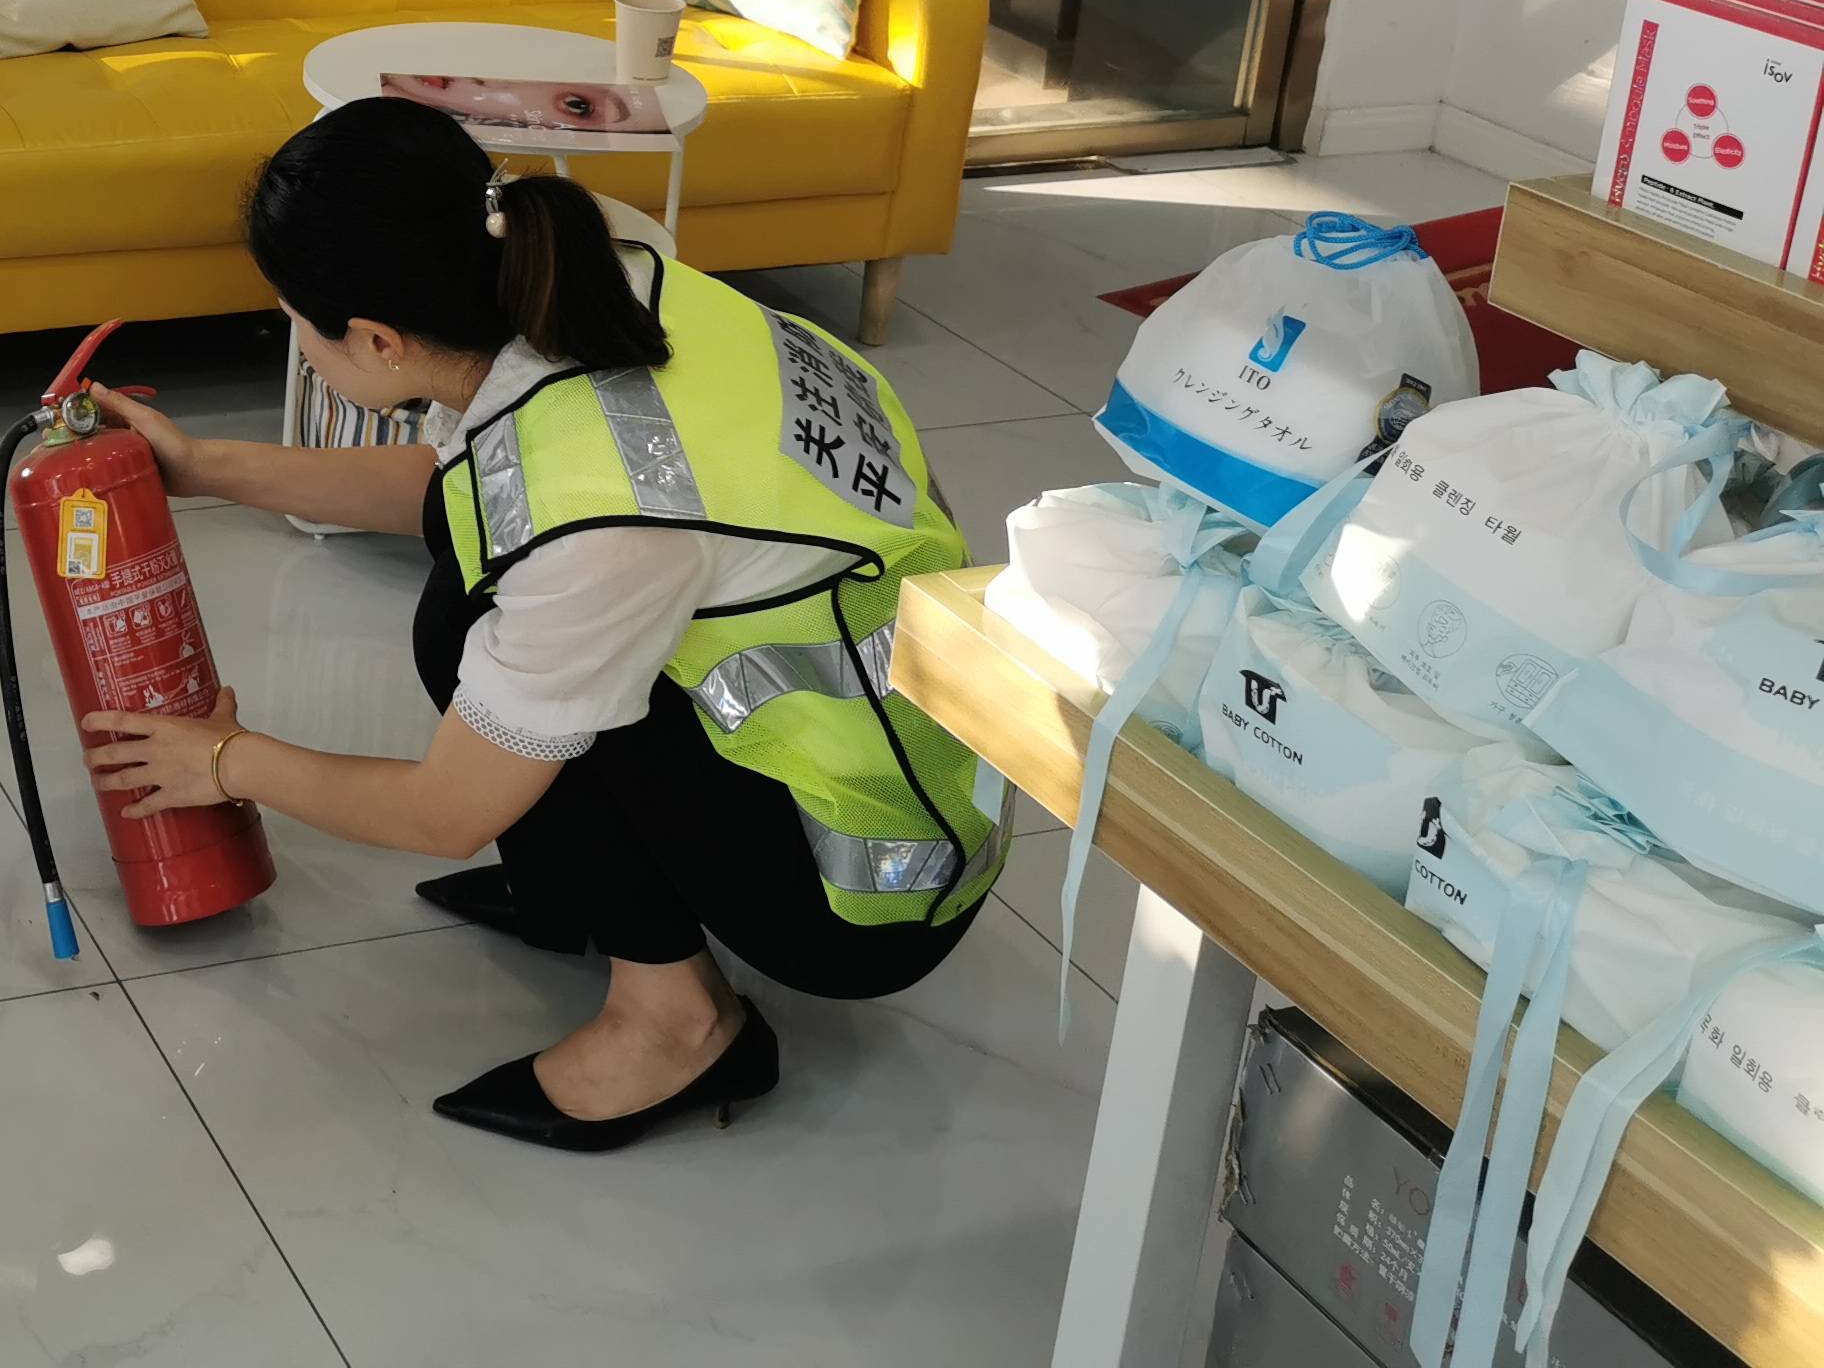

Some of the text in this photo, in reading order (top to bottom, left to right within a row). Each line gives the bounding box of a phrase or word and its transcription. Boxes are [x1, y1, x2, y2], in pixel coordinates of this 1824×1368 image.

[1238, 365, 1271, 391] ITO
[1172, 367, 1313, 450] クレンジングタオル
[1432, 480, 1476, 516] 클렌징
[1484, 516, 1522, 546] 타월
[1758, 677, 1820, 710] BABY
[1220, 703, 1304, 766] BABY COTTON
[1413, 858, 1468, 906] COTTON
[1729, 1044, 1774, 1094] 일회용
